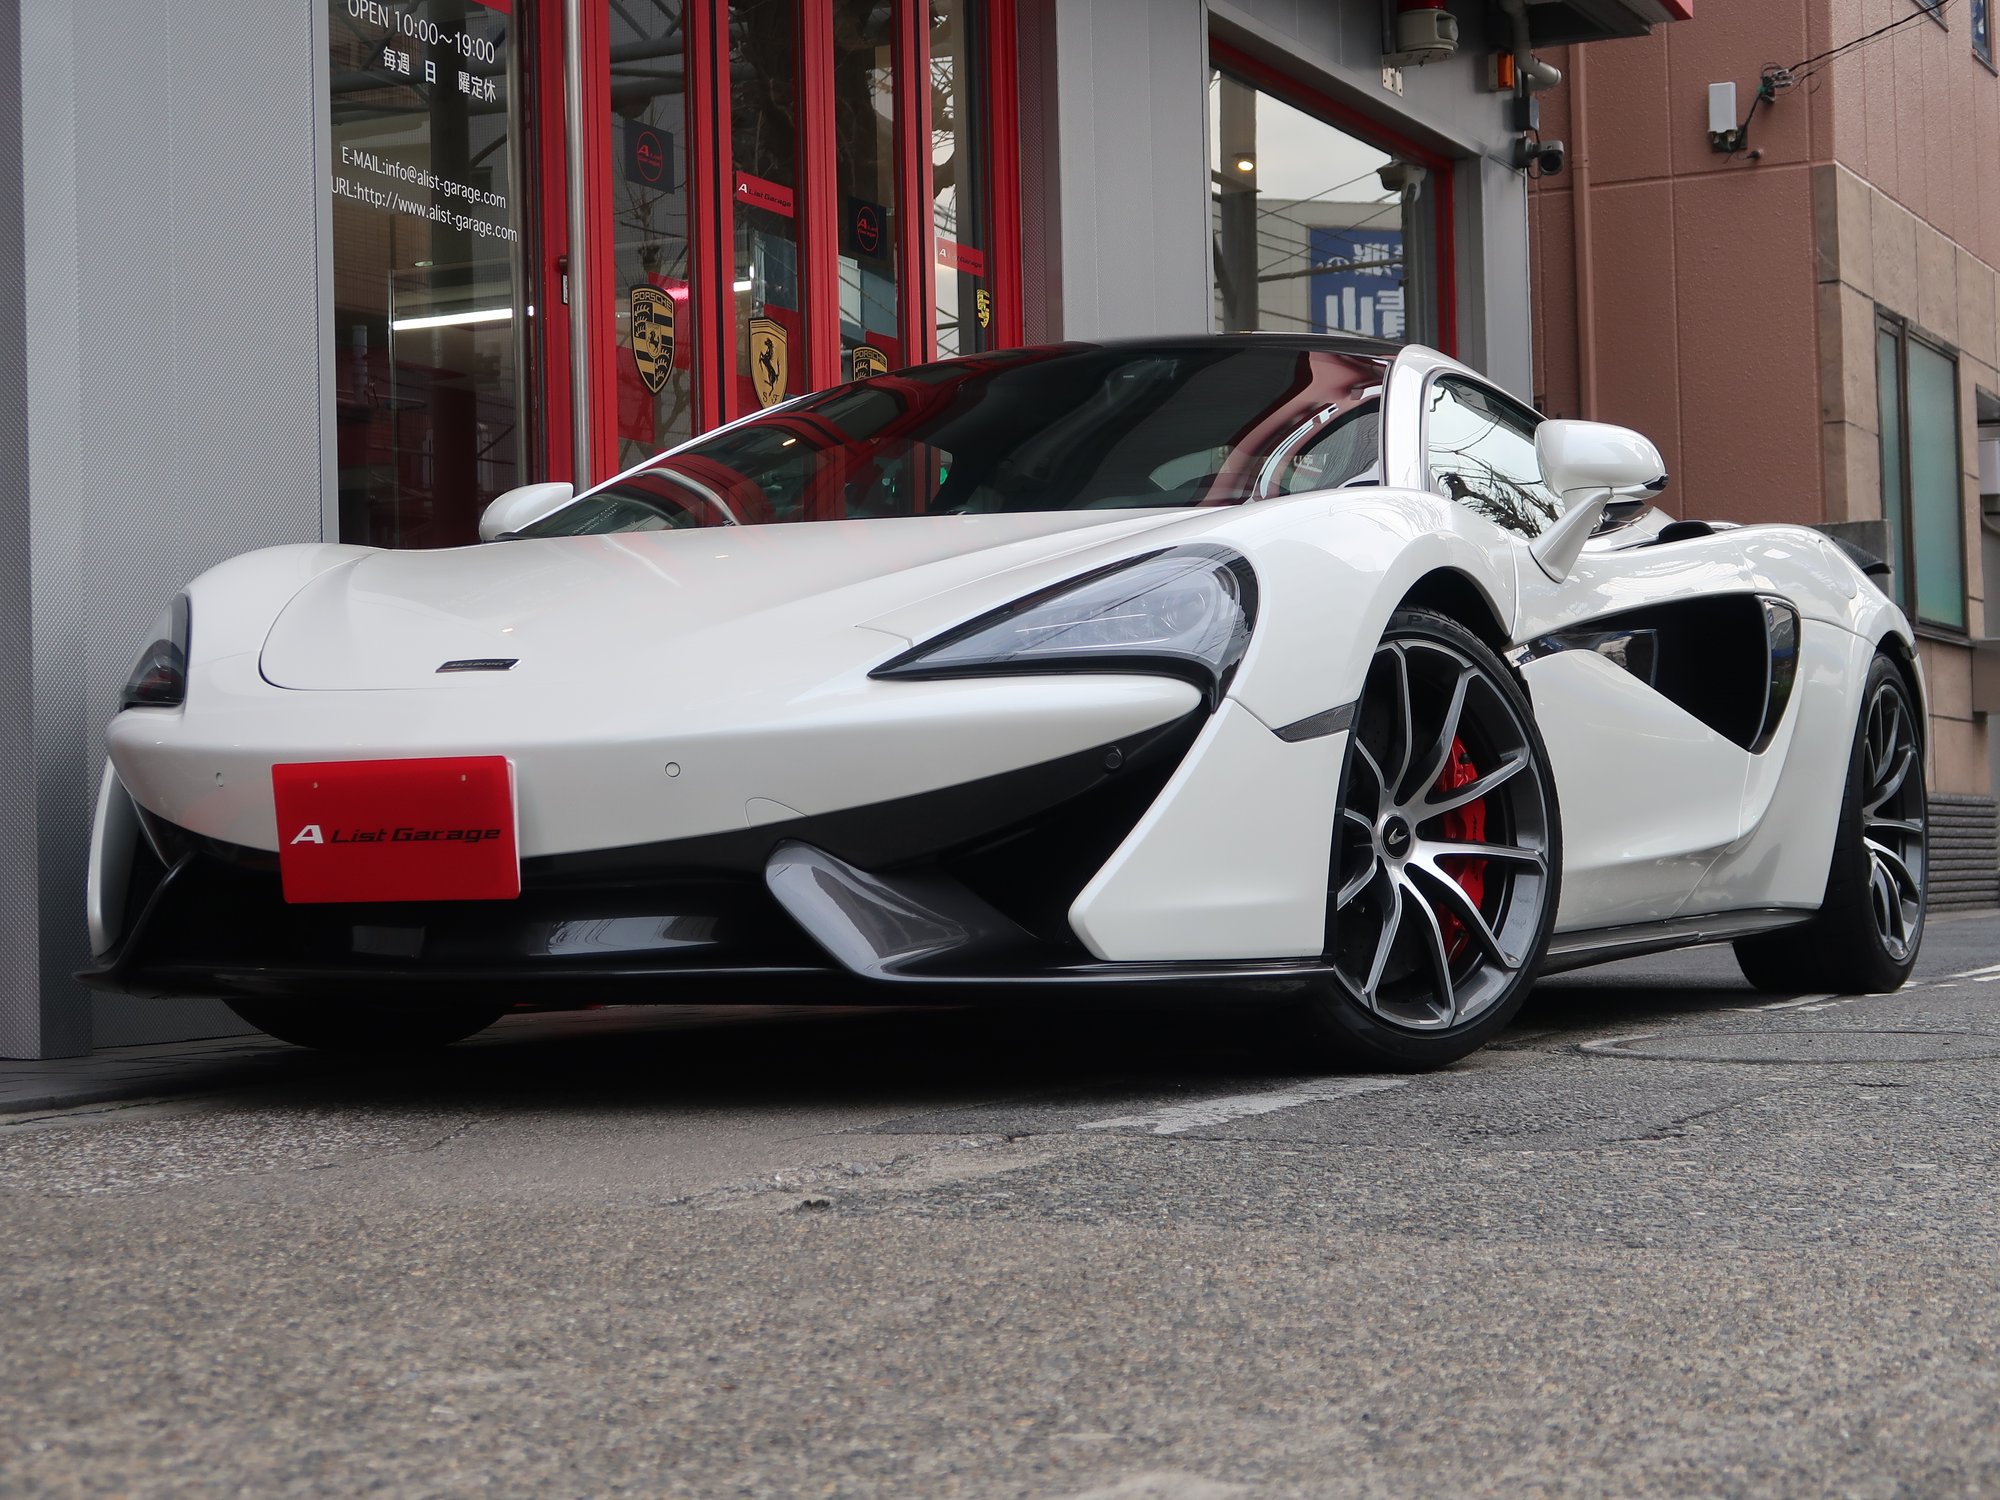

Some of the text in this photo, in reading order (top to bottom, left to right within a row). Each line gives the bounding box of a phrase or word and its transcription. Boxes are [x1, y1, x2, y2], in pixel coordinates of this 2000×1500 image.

[348, 0, 389, 28] OPEN
[383, 46, 497, 103] 毎週 日 曜定休
[342, 146, 507, 209] E-MAIL:info@alist-garage.com
[738, 183, 748, 194] A
[331, 175, 518, 242] URL:http://www.alist-garage.com
[938, 248, 948, 258] A
[633, 291, 672, 312] PORSCHE
[290, 824, 501, 845] A List Garage
